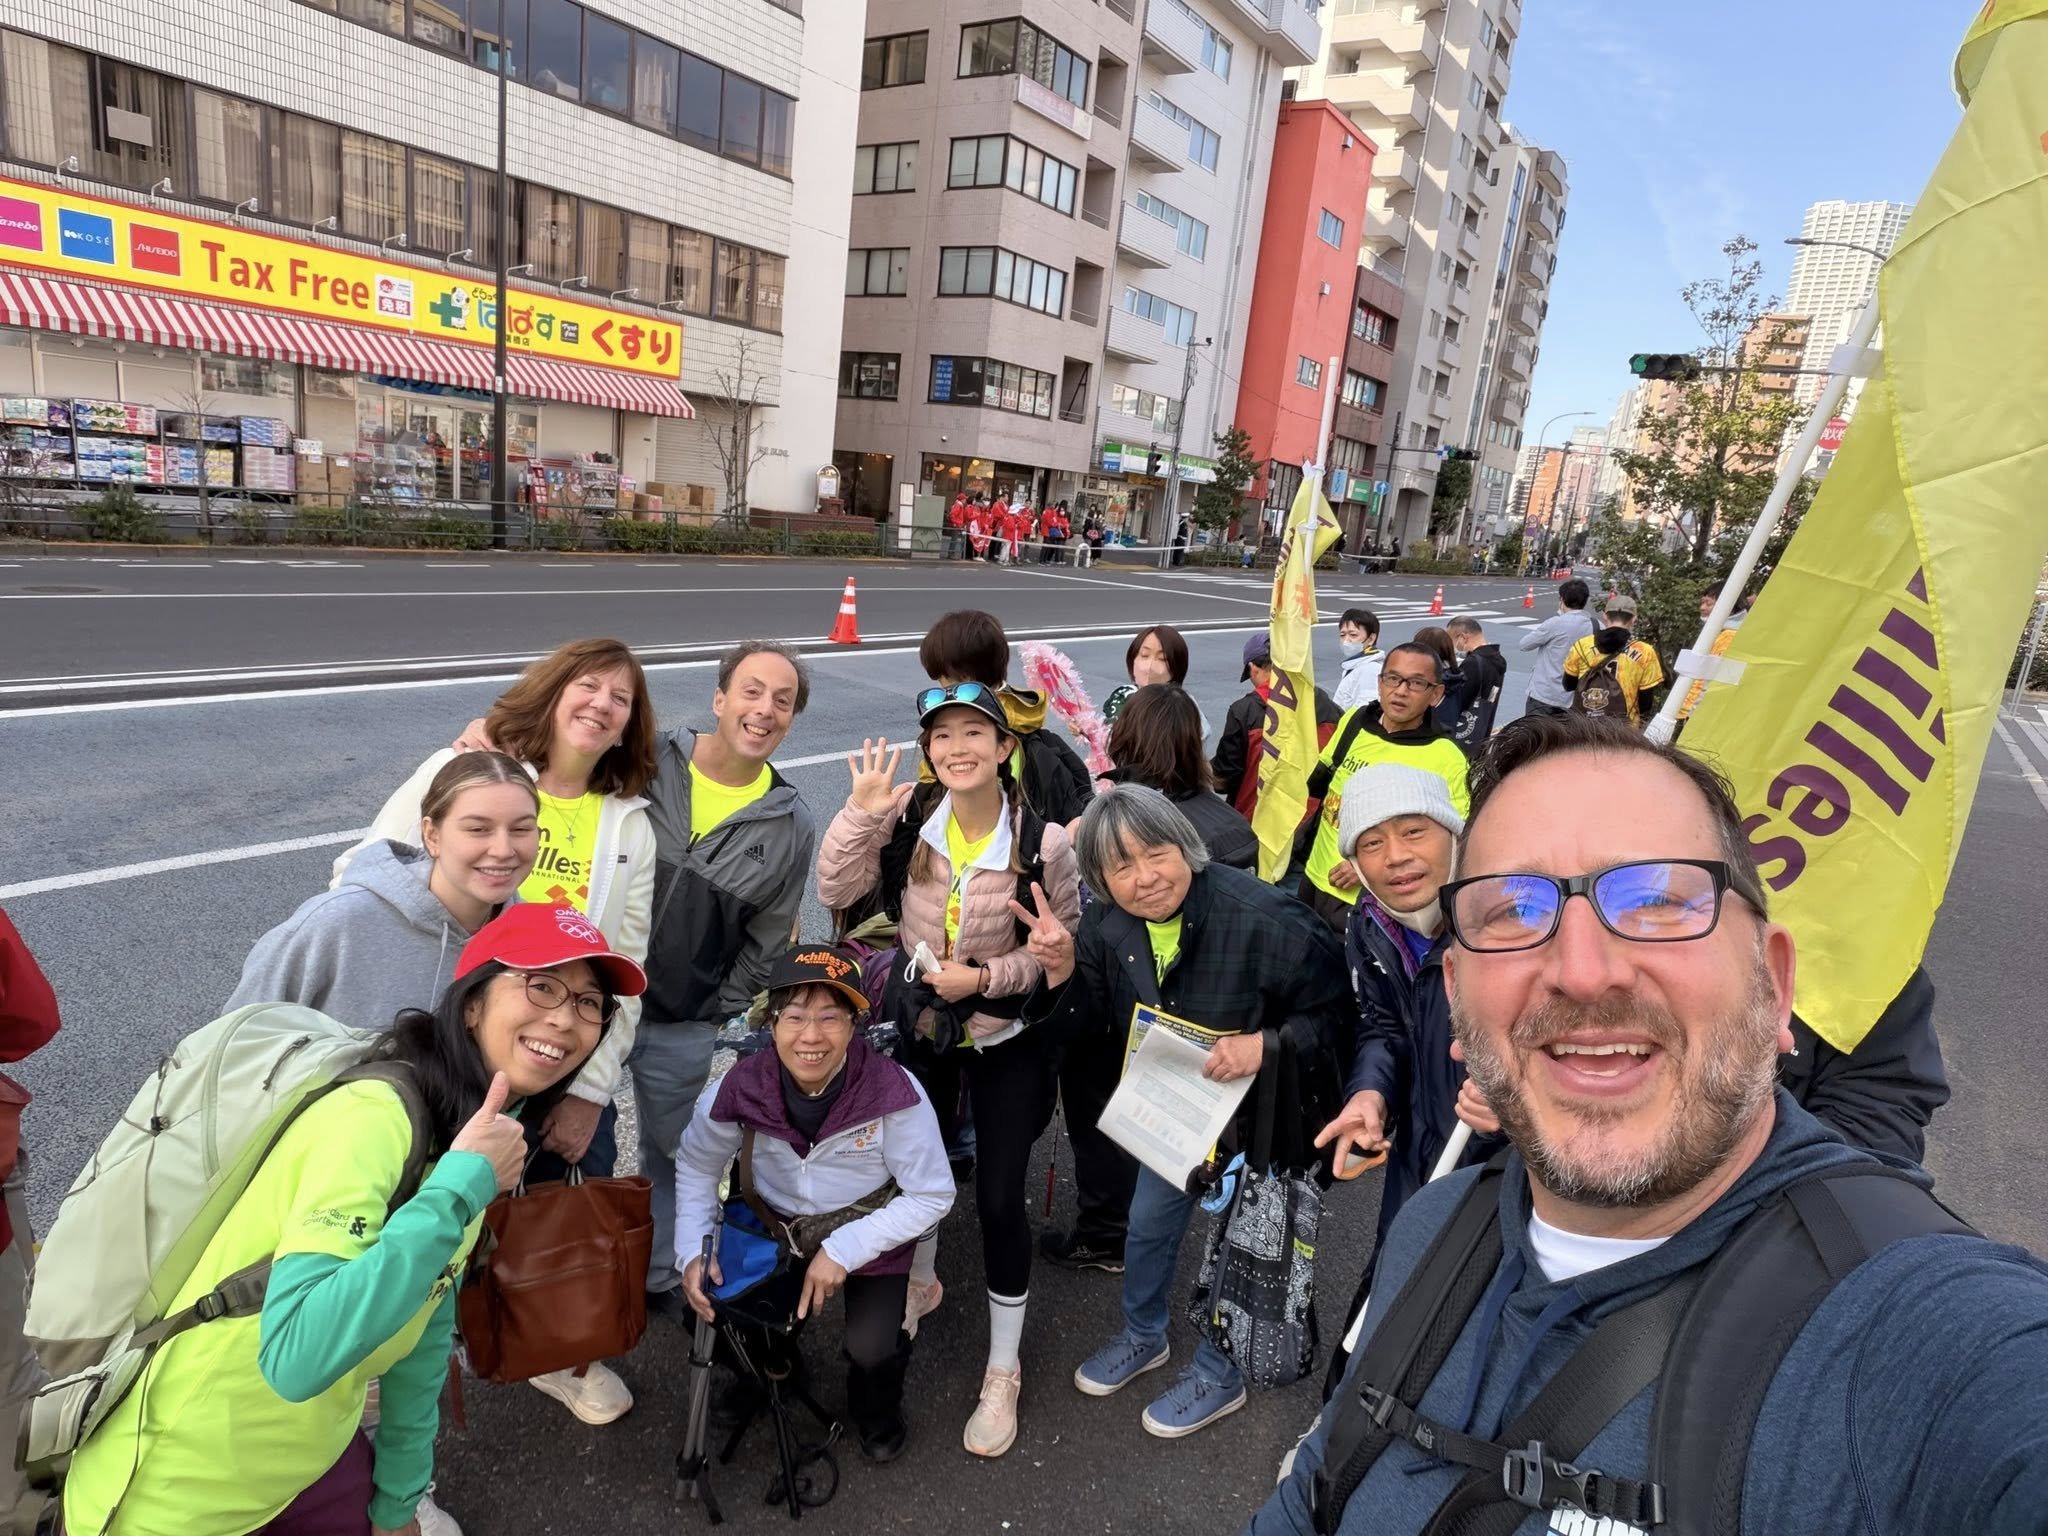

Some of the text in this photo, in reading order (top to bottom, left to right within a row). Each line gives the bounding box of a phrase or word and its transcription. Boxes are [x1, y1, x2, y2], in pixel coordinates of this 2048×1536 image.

[0, 216, 38, 231] anebo
[77, 232, 110, 245] KOSÉ
[134, 243, 177, 257] SHISEIDO
[200, 240, 369, 309] Tax Free
[592, 320, 672, 365] くすり
[744, 849, 766, 865] adidas
[794, 952, 841, 966] Achilles
[1549, 1508, 1650, 1536] IRON
